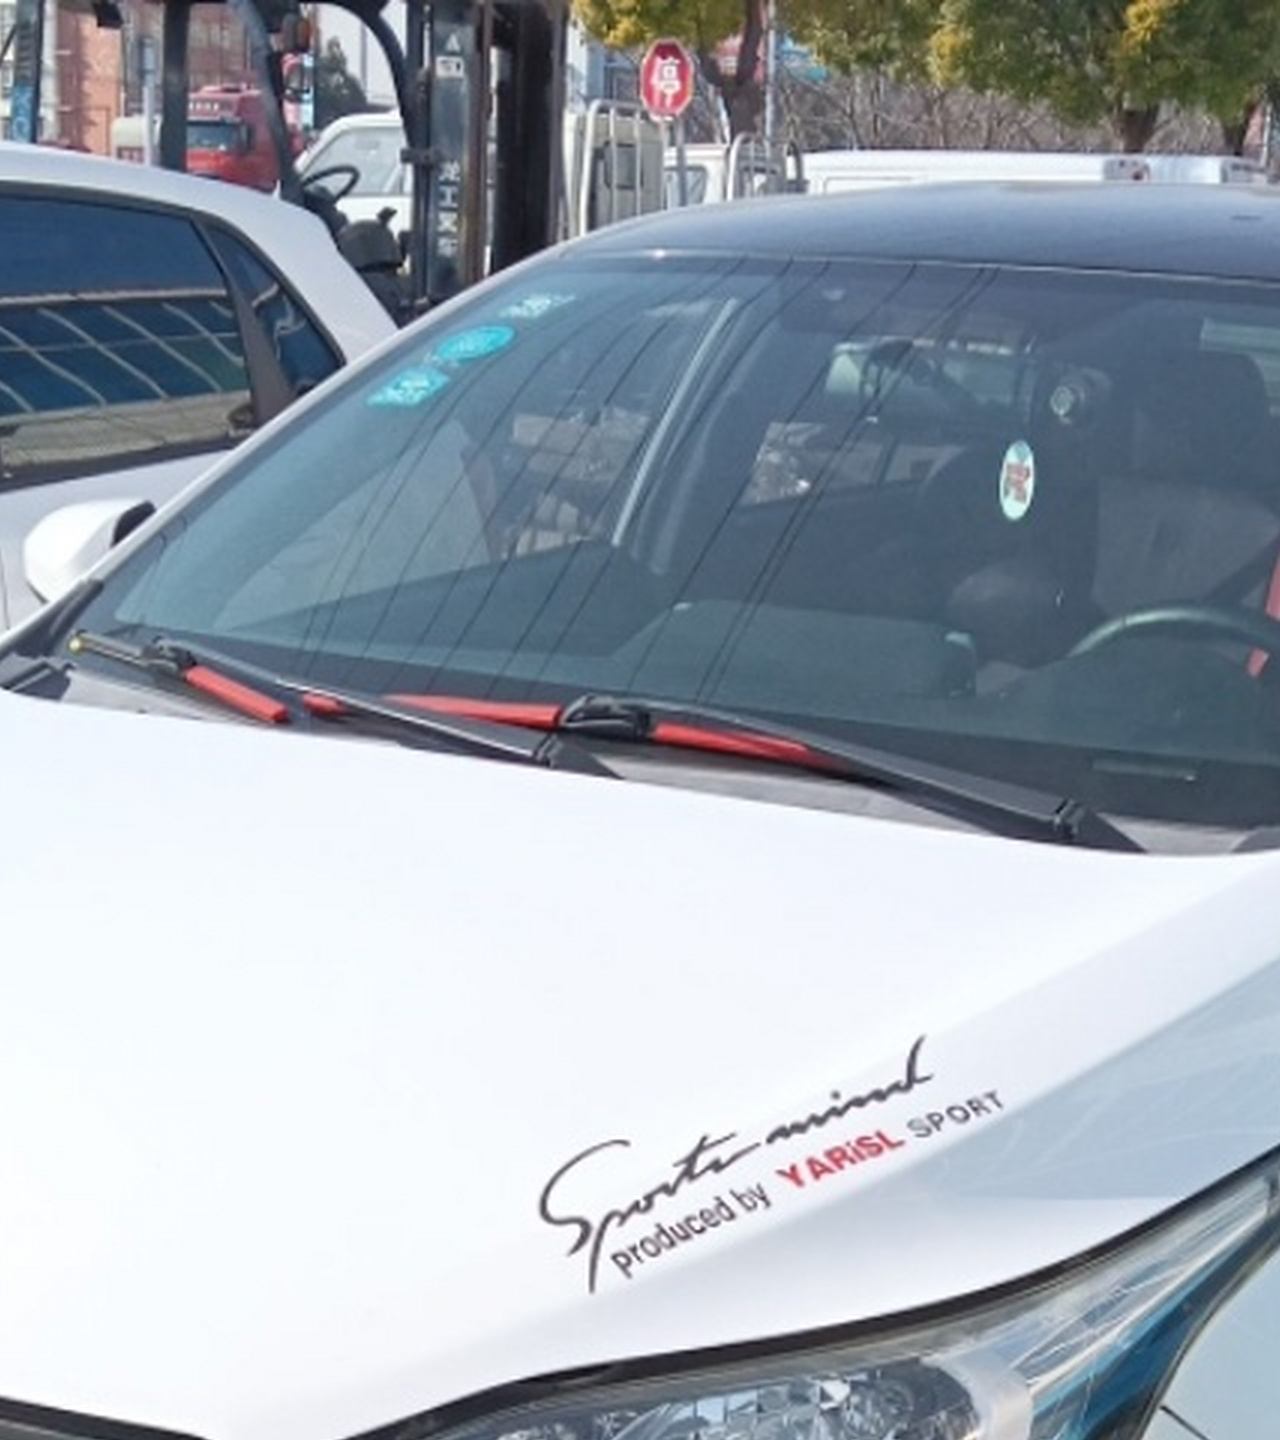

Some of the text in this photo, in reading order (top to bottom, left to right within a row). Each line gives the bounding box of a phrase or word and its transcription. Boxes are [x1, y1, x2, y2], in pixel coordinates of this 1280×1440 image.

[540, 1133, 761, 1293] Sports
[611, 1197, 734, 1278] produced
[730, 1182, 771, 1210] by
[907, 1090, 1005, 1140] SPORT
